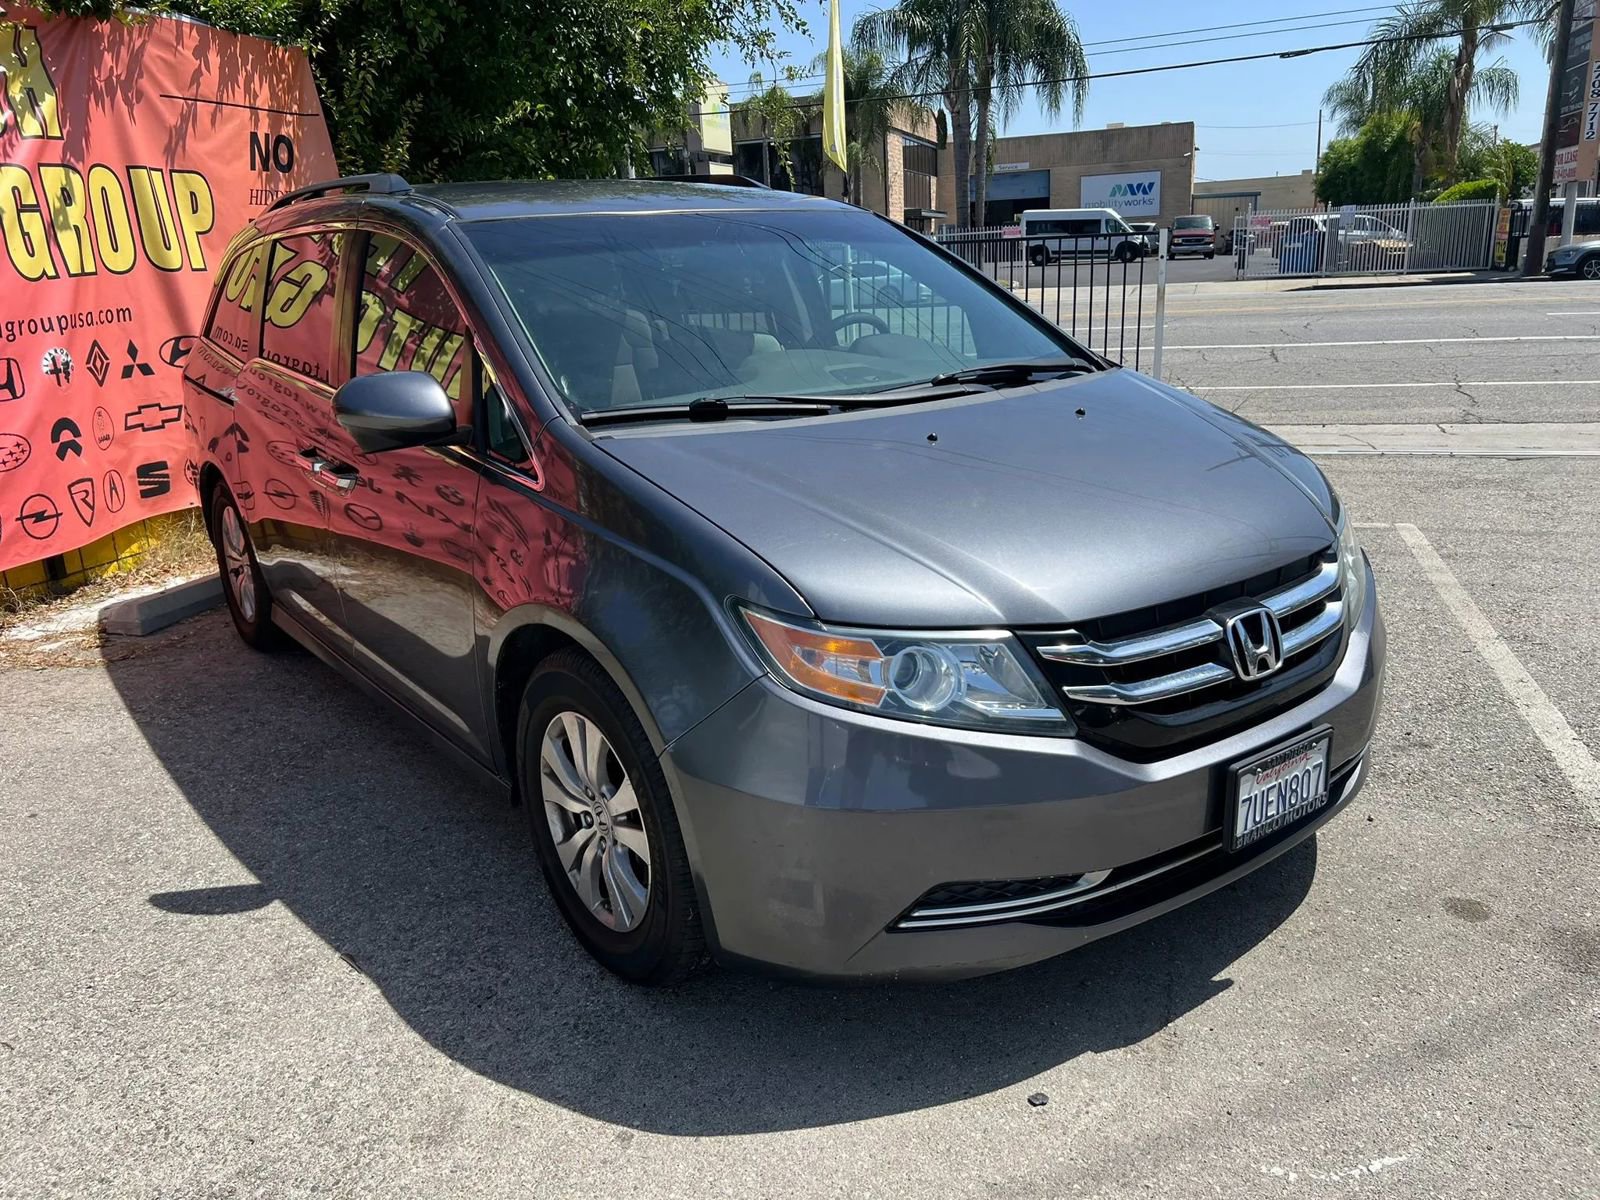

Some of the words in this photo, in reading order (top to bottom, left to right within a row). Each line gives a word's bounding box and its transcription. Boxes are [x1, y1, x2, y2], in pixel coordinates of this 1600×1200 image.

[1585, 103, 1598, 139] 7712
[249, 131, 294, 173] NO
[0, 163, 215, 281] GROUP
[1255, 752, 1312, 784] California
[1240, 761, 1323, 831] 7UEN807
[1283, 793, 1328, 827] MOTORS
